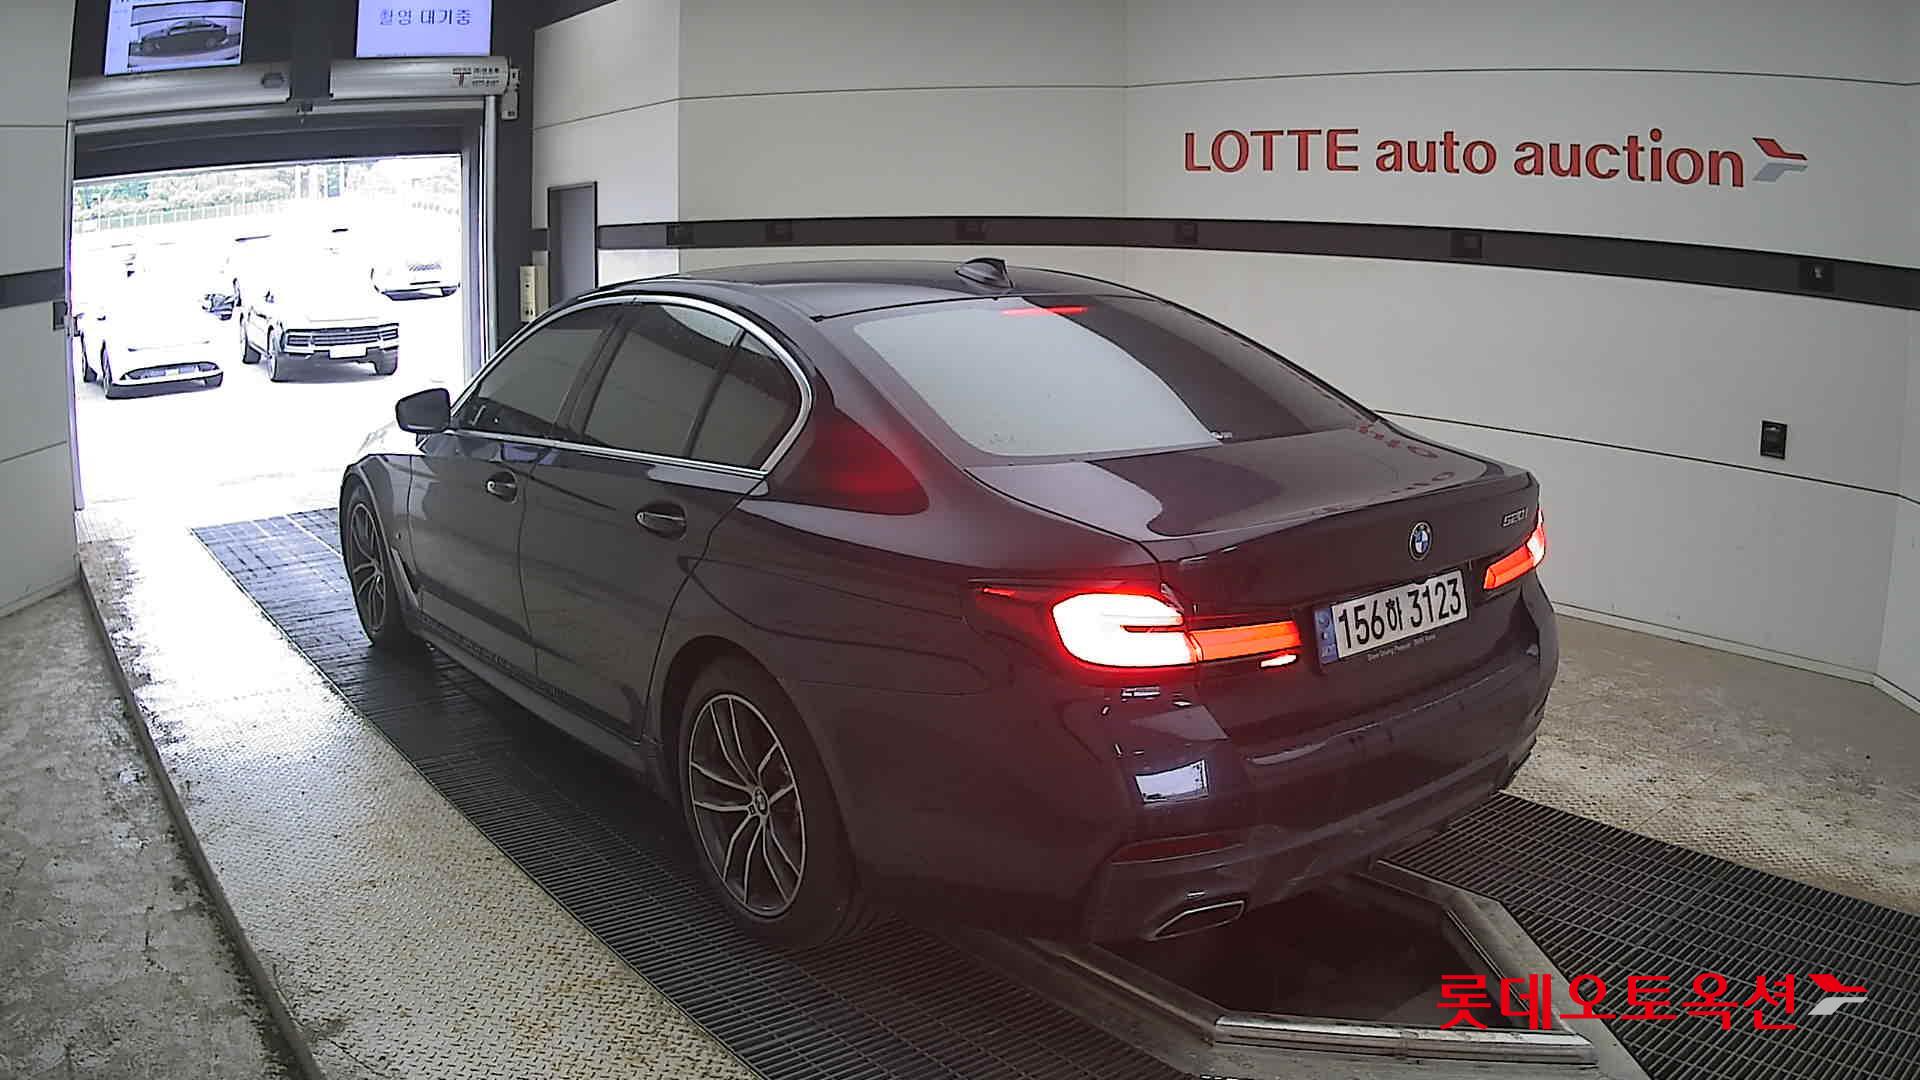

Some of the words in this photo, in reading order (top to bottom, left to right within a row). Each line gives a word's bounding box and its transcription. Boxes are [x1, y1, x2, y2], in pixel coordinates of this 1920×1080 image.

[420, 9, 472, 26] 대기중
[1184, 128, 1360, 173] LOTTE
[1375, 130, 1497, 175] auto
[1513, 127, 1745, 188] auction
[1338, 595, 1403, 649] 156하
[1408, 577, 1462, 628] 3123
